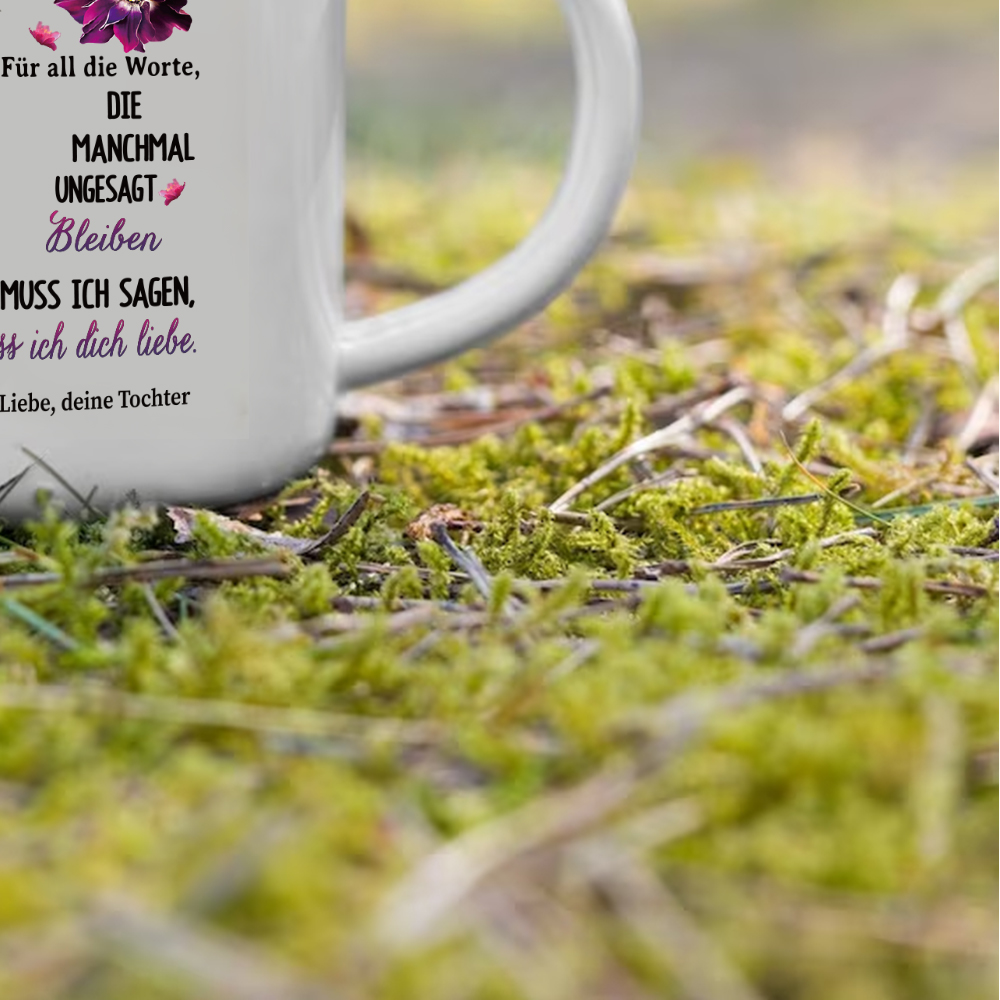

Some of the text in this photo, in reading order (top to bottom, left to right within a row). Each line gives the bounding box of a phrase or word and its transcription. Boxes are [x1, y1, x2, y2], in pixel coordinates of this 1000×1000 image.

[1, 55, 200, 80] Für all die Worte,
[107, 91, 142, 119] DIE
[72, 133, 195, 164] MANCHMAL
[55, 174, 158, 204] UNGESAGT
[46, 210, 162, 253] Bleiben
[0, 275, 195, 310] MUSS ICH SAGEN,
[30, 321, 67, 360] ich
[76, 319, 127, 358] dich
[137, 317, 196, 356] liebe.
[0, 392, 55, 416] Liebe,
[61, 391, 113, 411] deine
[118, 388, 190, 408] Tochter
